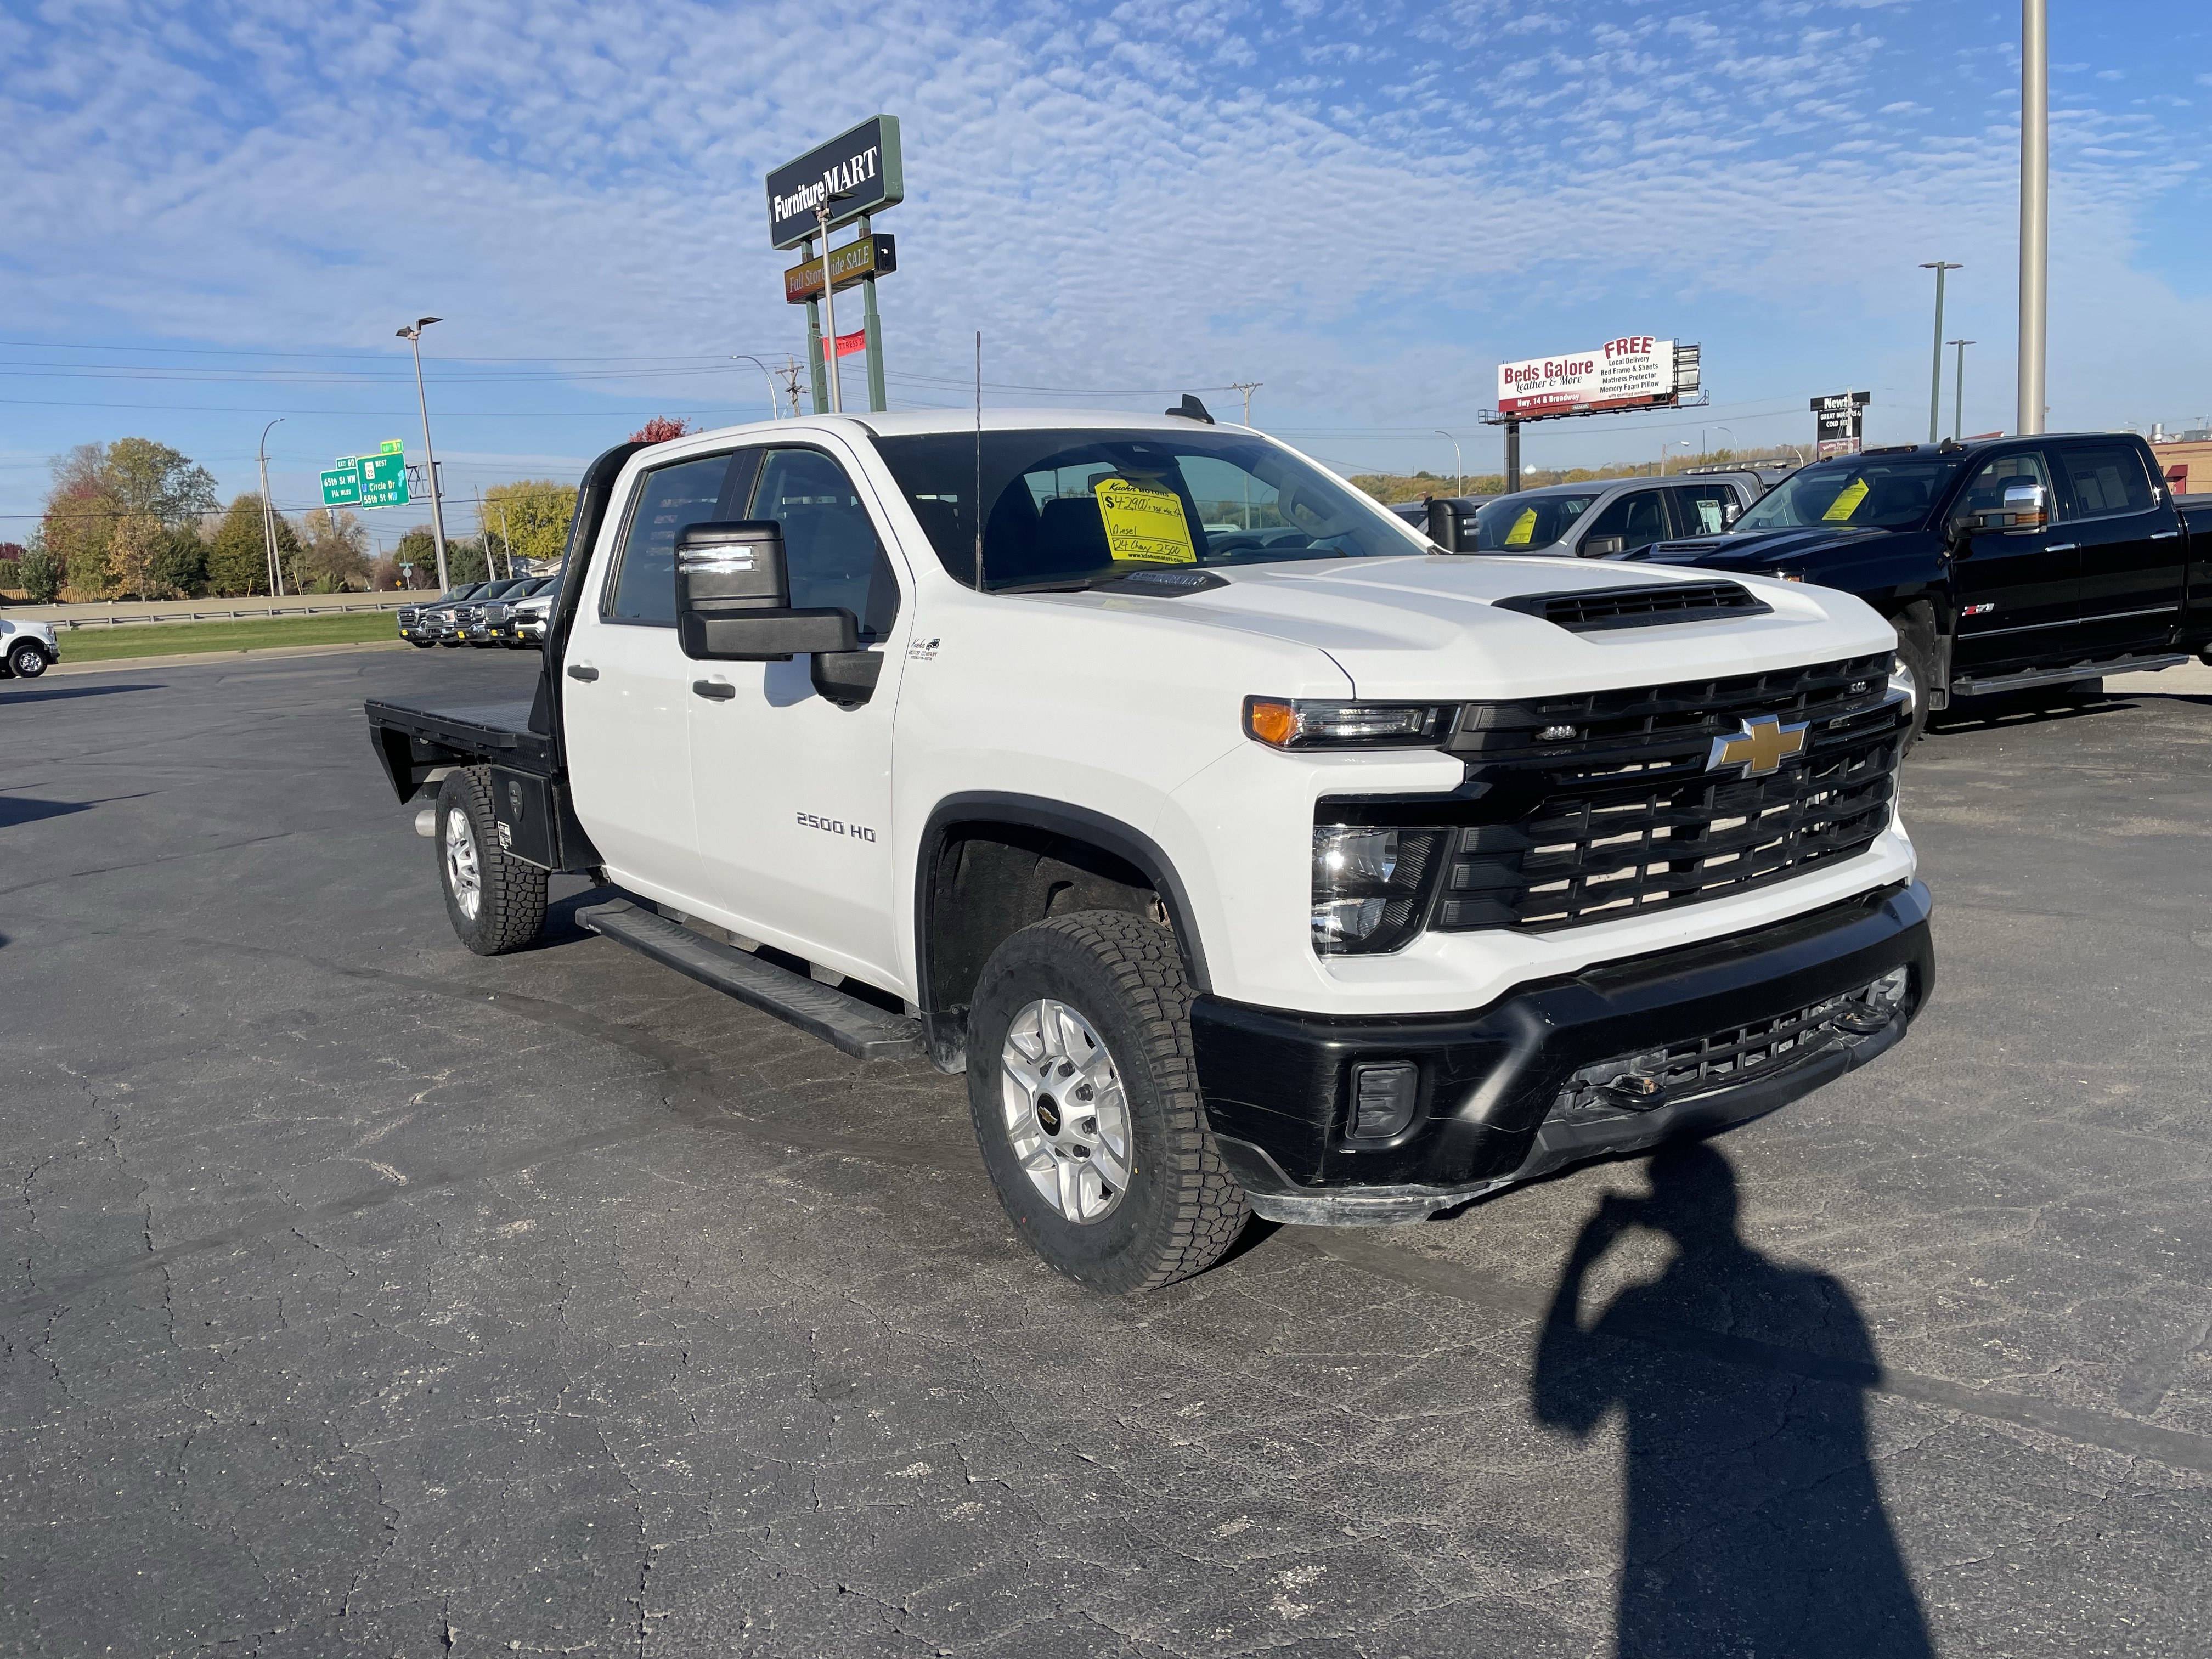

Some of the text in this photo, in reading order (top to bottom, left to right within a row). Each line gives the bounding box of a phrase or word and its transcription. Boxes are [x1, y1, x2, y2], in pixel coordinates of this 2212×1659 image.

[774, 146, 878, 223] FurnitureMART
[789, 272, 804, 293] Fall
[846, 245, 869, 270] SALE
[836, 340, 858, 350] ATTRESS
[1604, 337, 1654, 359] FREE
[1609, 356, 1650, 366] Local Delivery
[1638, 363, 1658, 371] Sheets
[1504, 359, 1593, 385] Beds Galore
[1515, 375, 1582, 394] Leather & More
[1602, 373, 1657, 385] Mattress Protector
[1600, 385, 1622, 393] Memory
[1641, 380, 1660, 388] Pillow
[1517, 399, 1532, 408] Hwy.
[1549, 393, 1580, 403] Broadway
[1820, 413, 1835, 421] GREAT
[347, 459, 355, 467] 60
[375, 459, 387, 467] WEST
[324, 475, 356, 487] 65th St NW
[369, 482, 386, 492] Circle
[387, 480, 396, 489] Dr
[363, 491, 397, 504] 55th St NW
[1138, 488, 1169, 497] MOTORS
[1113, 524, 1137, 535] Diesel
[1114, 539, 1181, 555] 24 Chevy 2500
[796, 811, 876, 843] 2500 HD
